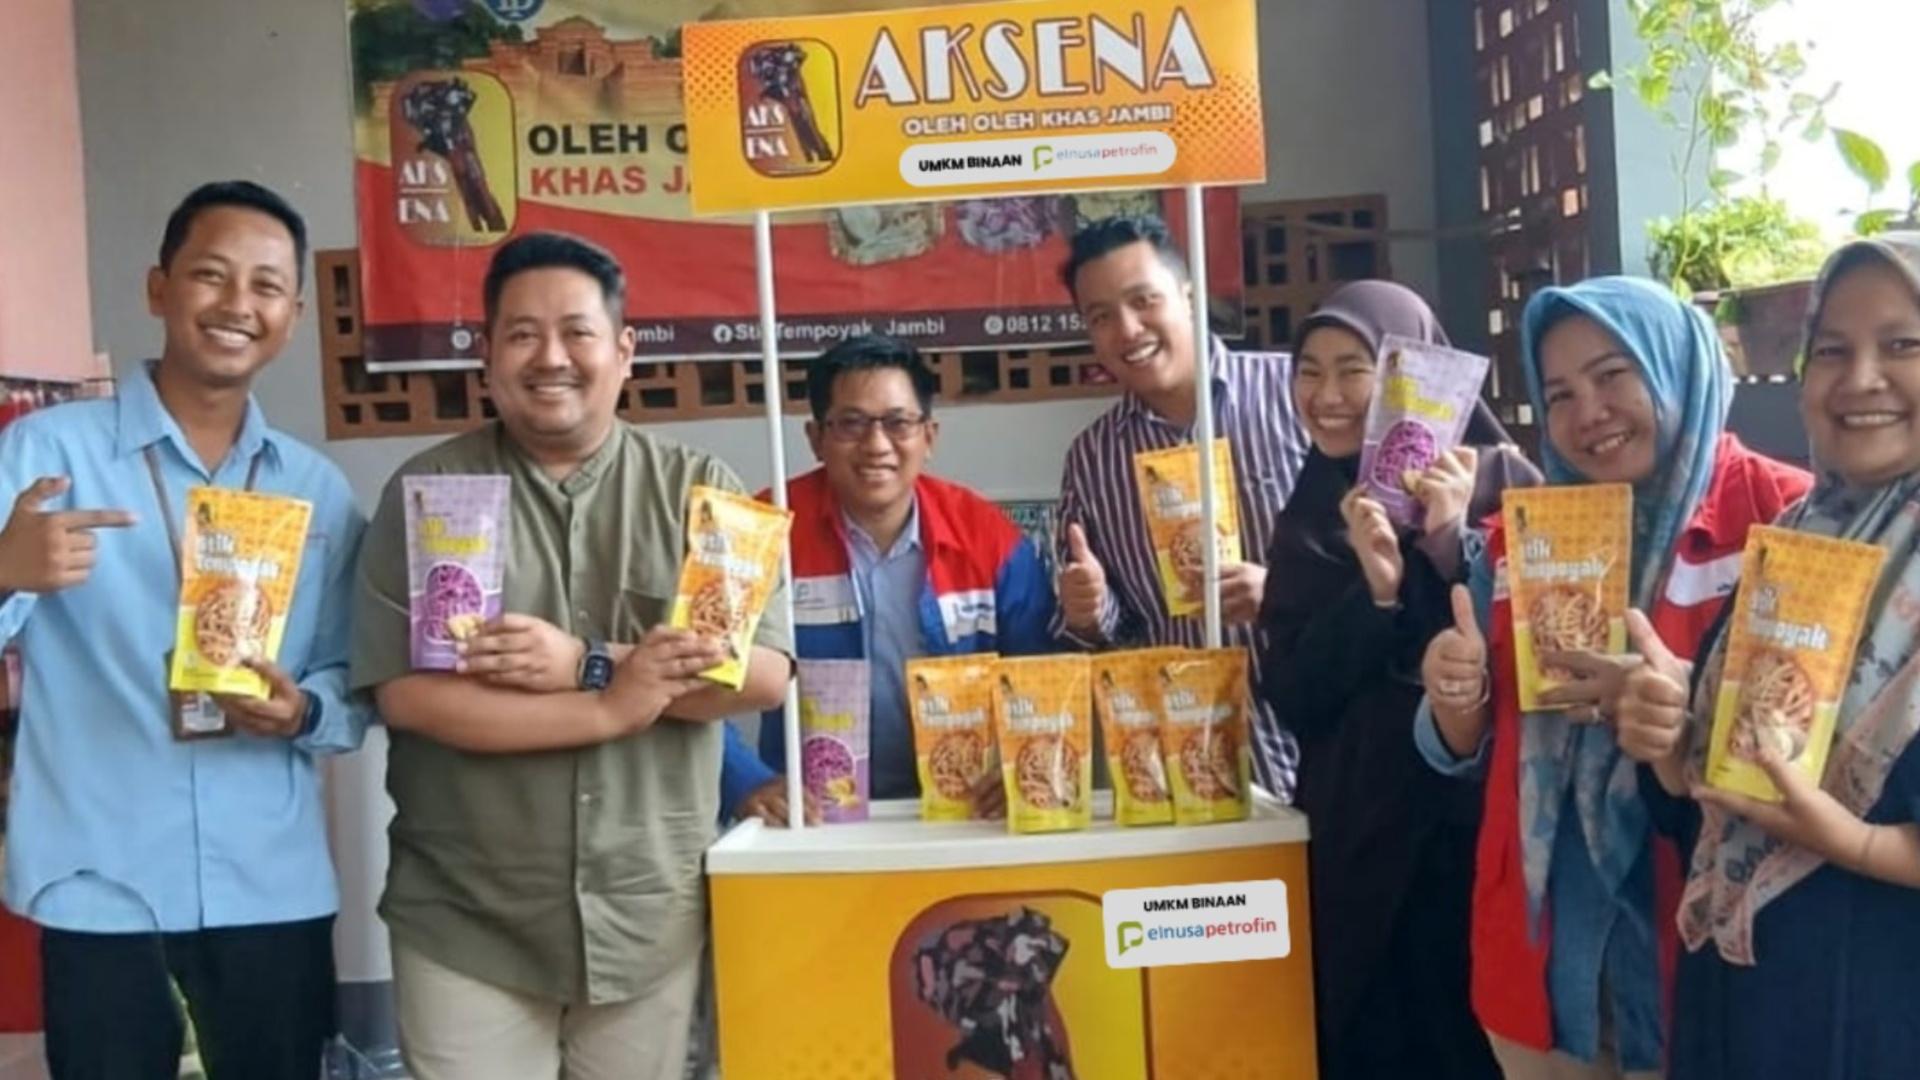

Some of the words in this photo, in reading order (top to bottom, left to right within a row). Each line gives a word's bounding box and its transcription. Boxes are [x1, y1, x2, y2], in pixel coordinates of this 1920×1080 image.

[854, 7, 1215, 109] AKSENA
[904, 117, 967, 136] OLEH
[973, 112, 1035, 131] OLEH
[1041, 109, 1100, 128] KHAS
[1107, 105, 1172, 124] JAMBI
[527, 123, 649, 155] OLEH
[918, 158, 965, 172] UMKM
[967, 154, 1023, 169] BINAAN
[1056, 143, 1158, 161] elnusapetrofin
[530, 167, 646, 196] KHAS
[1006, 315, 1052, 333] 0812
[1058, 313, 1087, 331] 15
[1143, 899, 1189, 912] UMKM
[1192, 894, 1246, 910] BINAAN
[1147, 917, 1278, 940] elnusapetrofin
